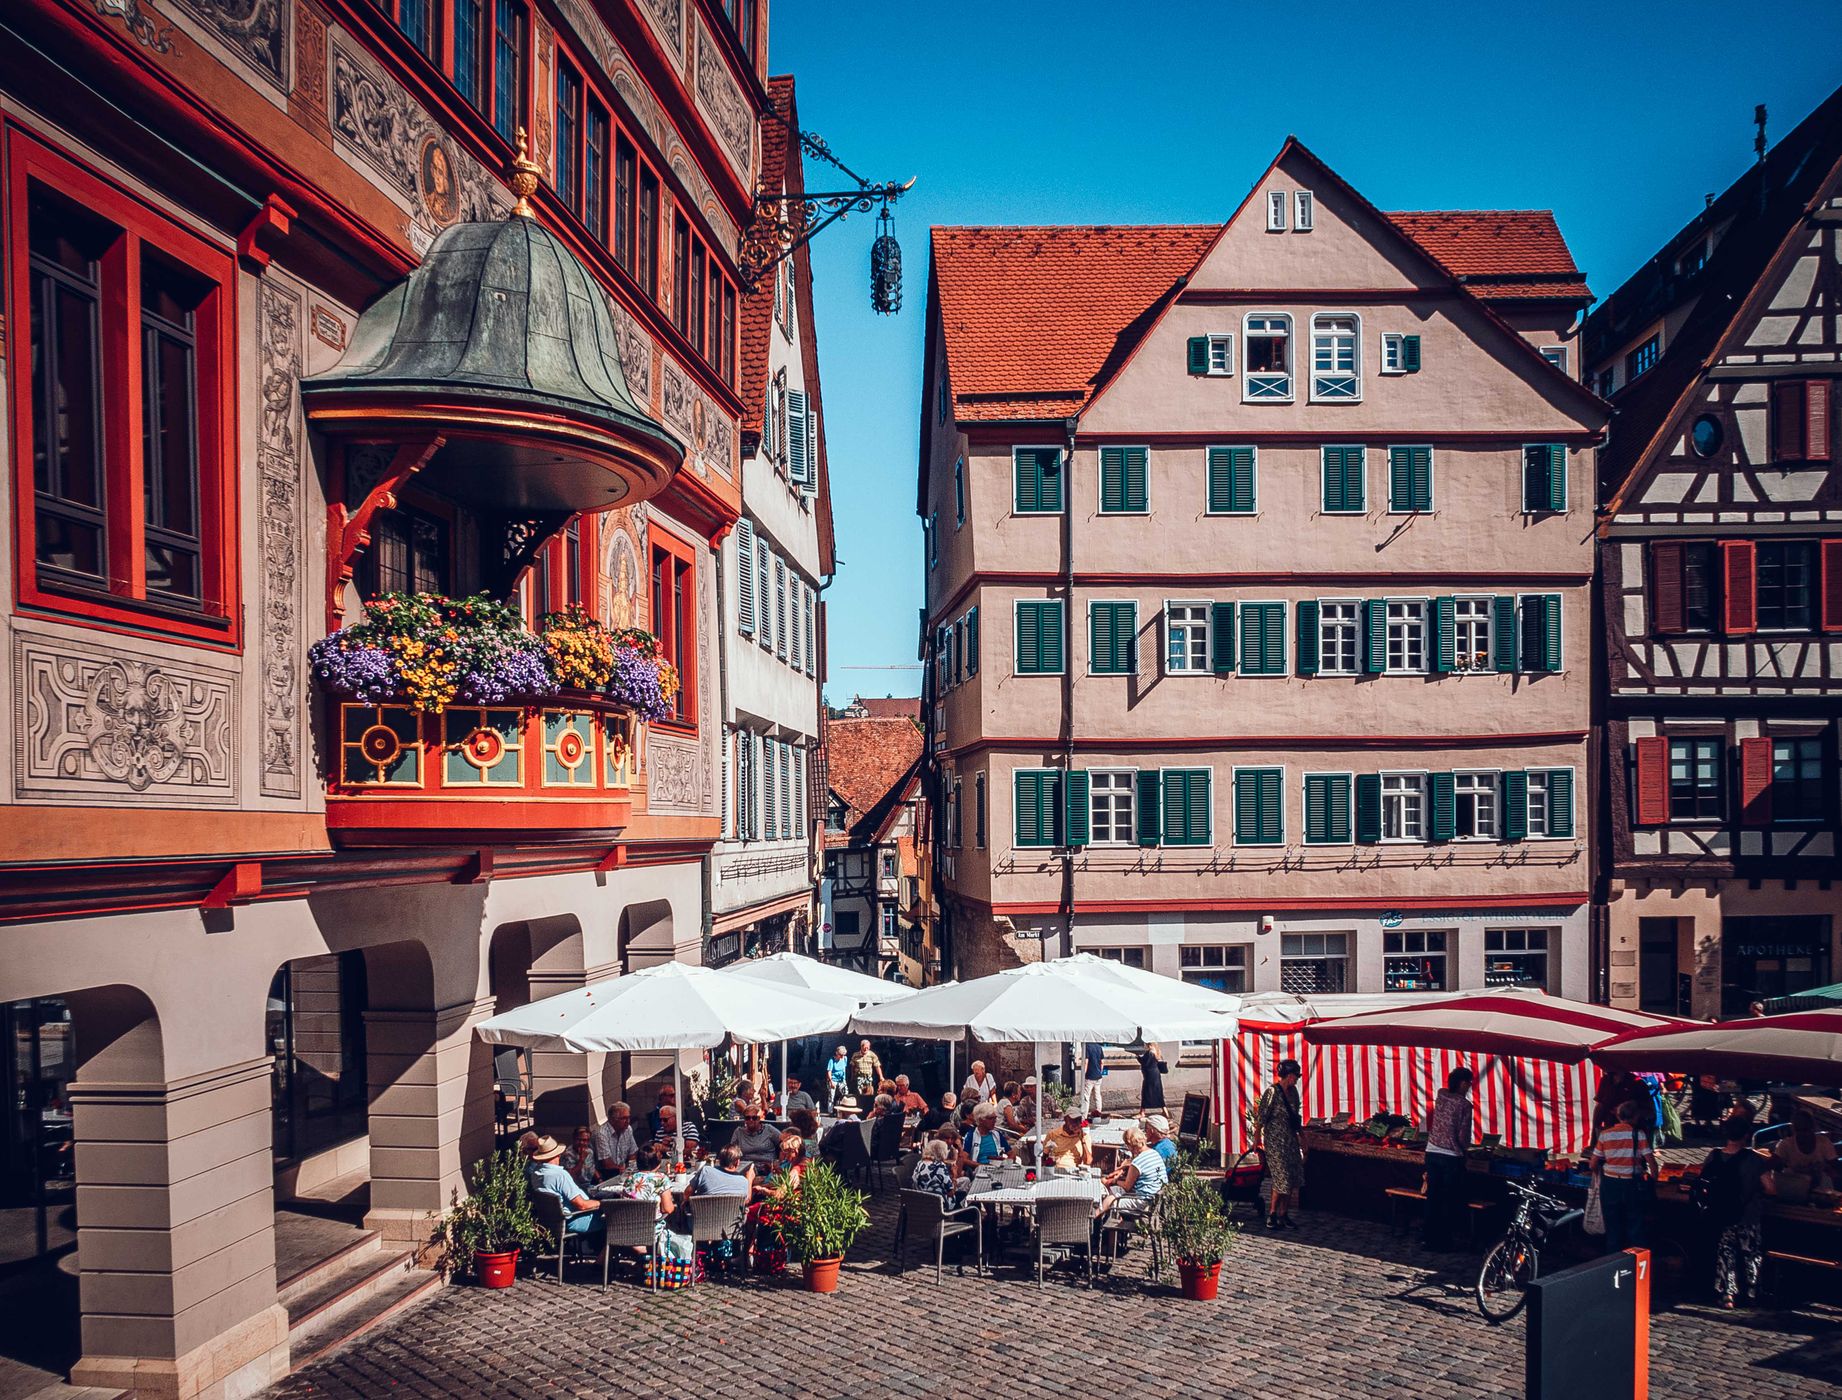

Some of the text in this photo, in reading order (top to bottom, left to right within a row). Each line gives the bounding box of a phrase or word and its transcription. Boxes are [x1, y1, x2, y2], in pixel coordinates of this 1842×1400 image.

[1382, 914, 1403, 926] FASS
[1736, 945, 1813, 955] APOTHEKE
[1638, 1260, 1647, 1280] 7
